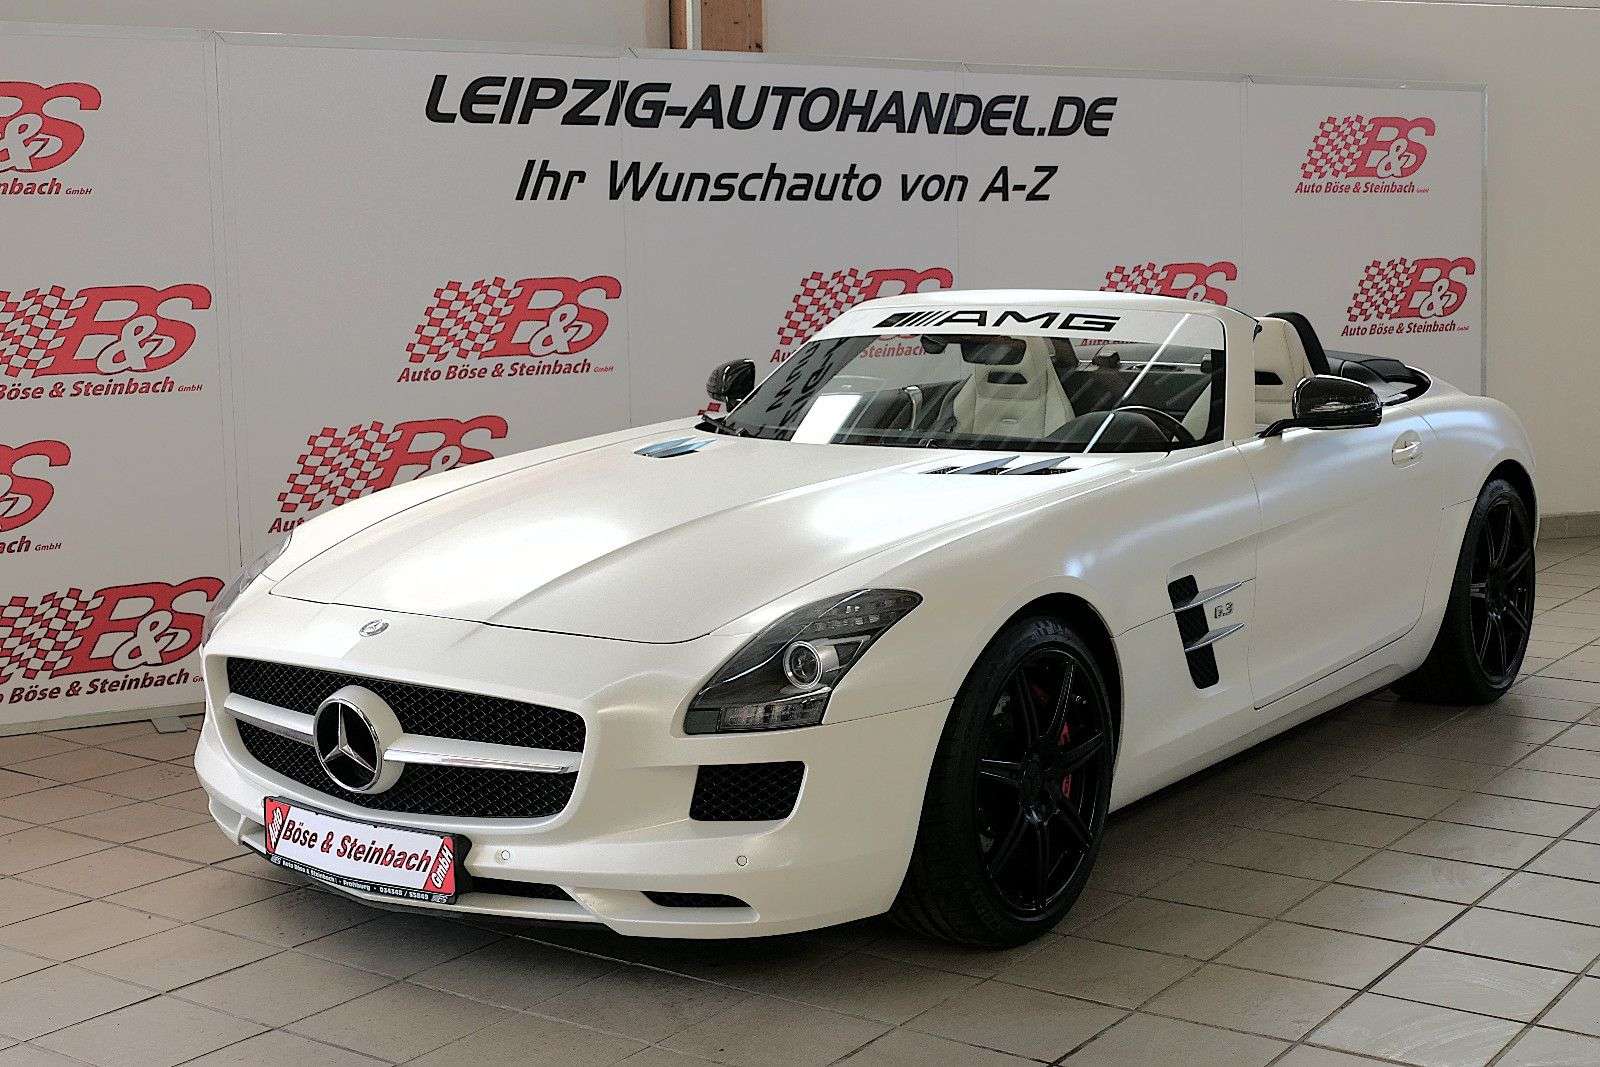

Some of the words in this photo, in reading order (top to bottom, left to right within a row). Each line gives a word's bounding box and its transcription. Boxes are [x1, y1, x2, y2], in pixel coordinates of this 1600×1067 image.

[425, 74, 1118, 137] LEIPZIG-AUTOHANDEL.DE
[0, 177, 62, 195] nbach
[65, 187, 92, 195] GmbH
[515, 159, 588, 201] Ihr
[608, 160, 882, 202] Wunschauto
[901, 173, 969, 202] von
[979, 165, 1059, 202] A-Z
[1295, 182, 1322, 194] Auto
[1325, 182, 1350, 194] Böse
[1352, 182, 1361, 193] &
[1363, 181, 1415, 194] Steinbach
[932, 310, 1121, 332] AMG
[1341, 325, 1367, 337] Auto
[1369, 323, 1394, 335] Böse
[1396, 323, 1405, 334] &
[1406, 320, 1456, 334] Steinbach
[397, 367, 441, 383] Auto
[445, 364, 487, 381] Böse
[491, 362, 504, 378] &
[507, 358, 591, 377] Steinbach
[48, 381, 66, 398] &
[70, 376, 175, 397] Steinbach
[34, 542, 62, 552] GmbH
[8, 685, 61, 705] Böse
[65, 680, 82, 697] &
[86, 668, 189, 695] Steinbach
[269, 807, 283, 848] Auto
[282, 819, 317, 849] Böse
[320, 831, 334, 854] &
[336, 834, 432, 873] Steinbach
[431, 844, 454, 888] GmbH
